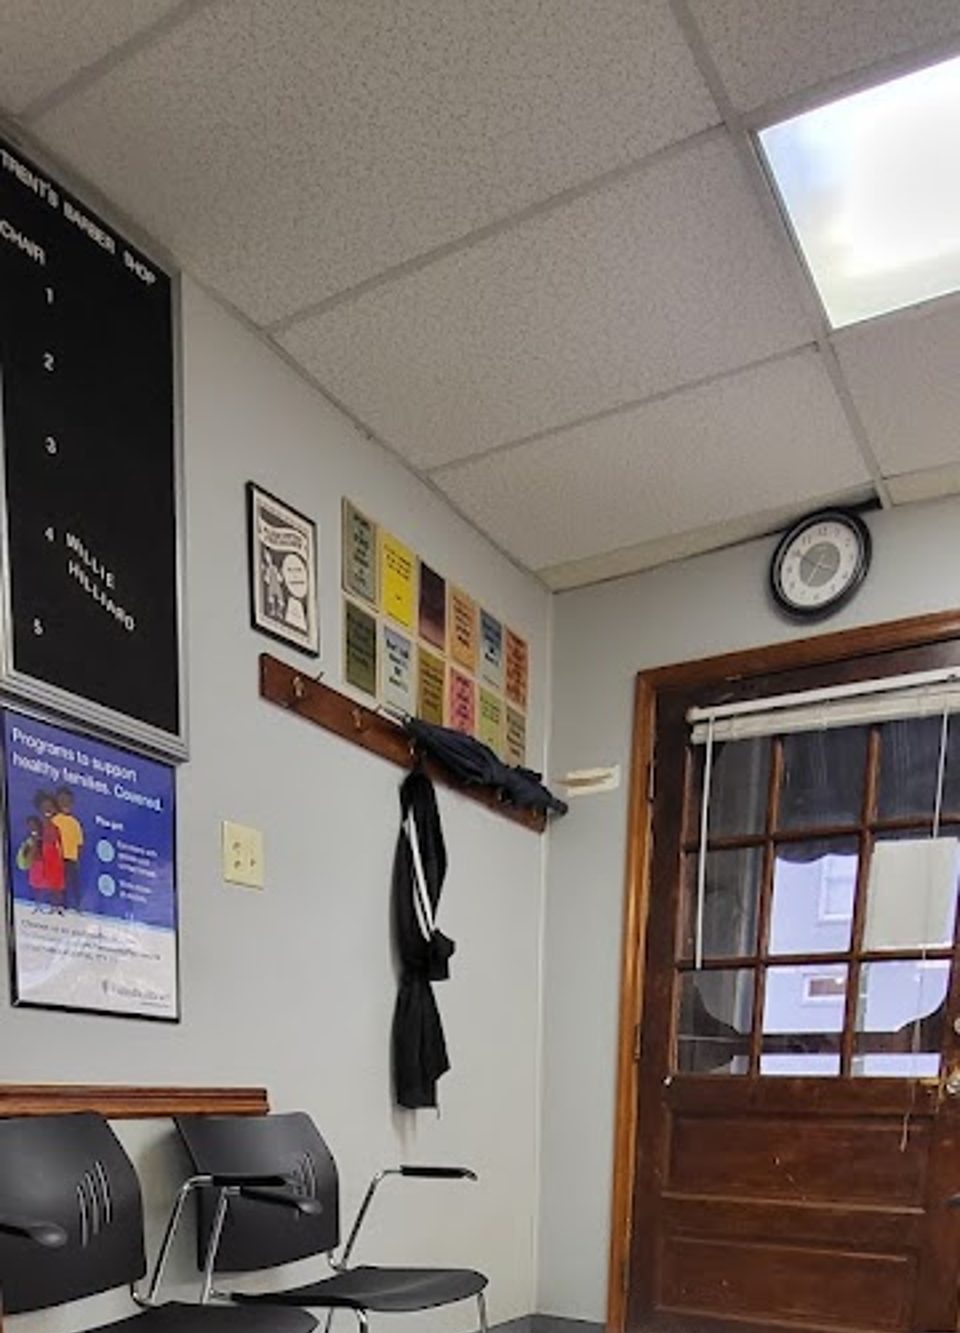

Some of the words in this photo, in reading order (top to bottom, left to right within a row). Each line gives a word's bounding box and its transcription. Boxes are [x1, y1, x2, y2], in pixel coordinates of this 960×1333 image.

[0, 219, 46, 266] CHAIR
[63, 201, 116, 254] BARBER
[123, 250, 156, 285] SHOP
[45, 286, 54, 304] 1
[44, 353, 55, 371] 2
[46, 436, 57, 454] 3
[66, 532, 115, 589] WILLIE
[69, 559, 135, 631] HILLIARD
[12, 727, 75, 762] Programs
[76, 751, 89, 767] to
[92, 757, 137, 784] support
[12, 751, 59, 782] healthy
